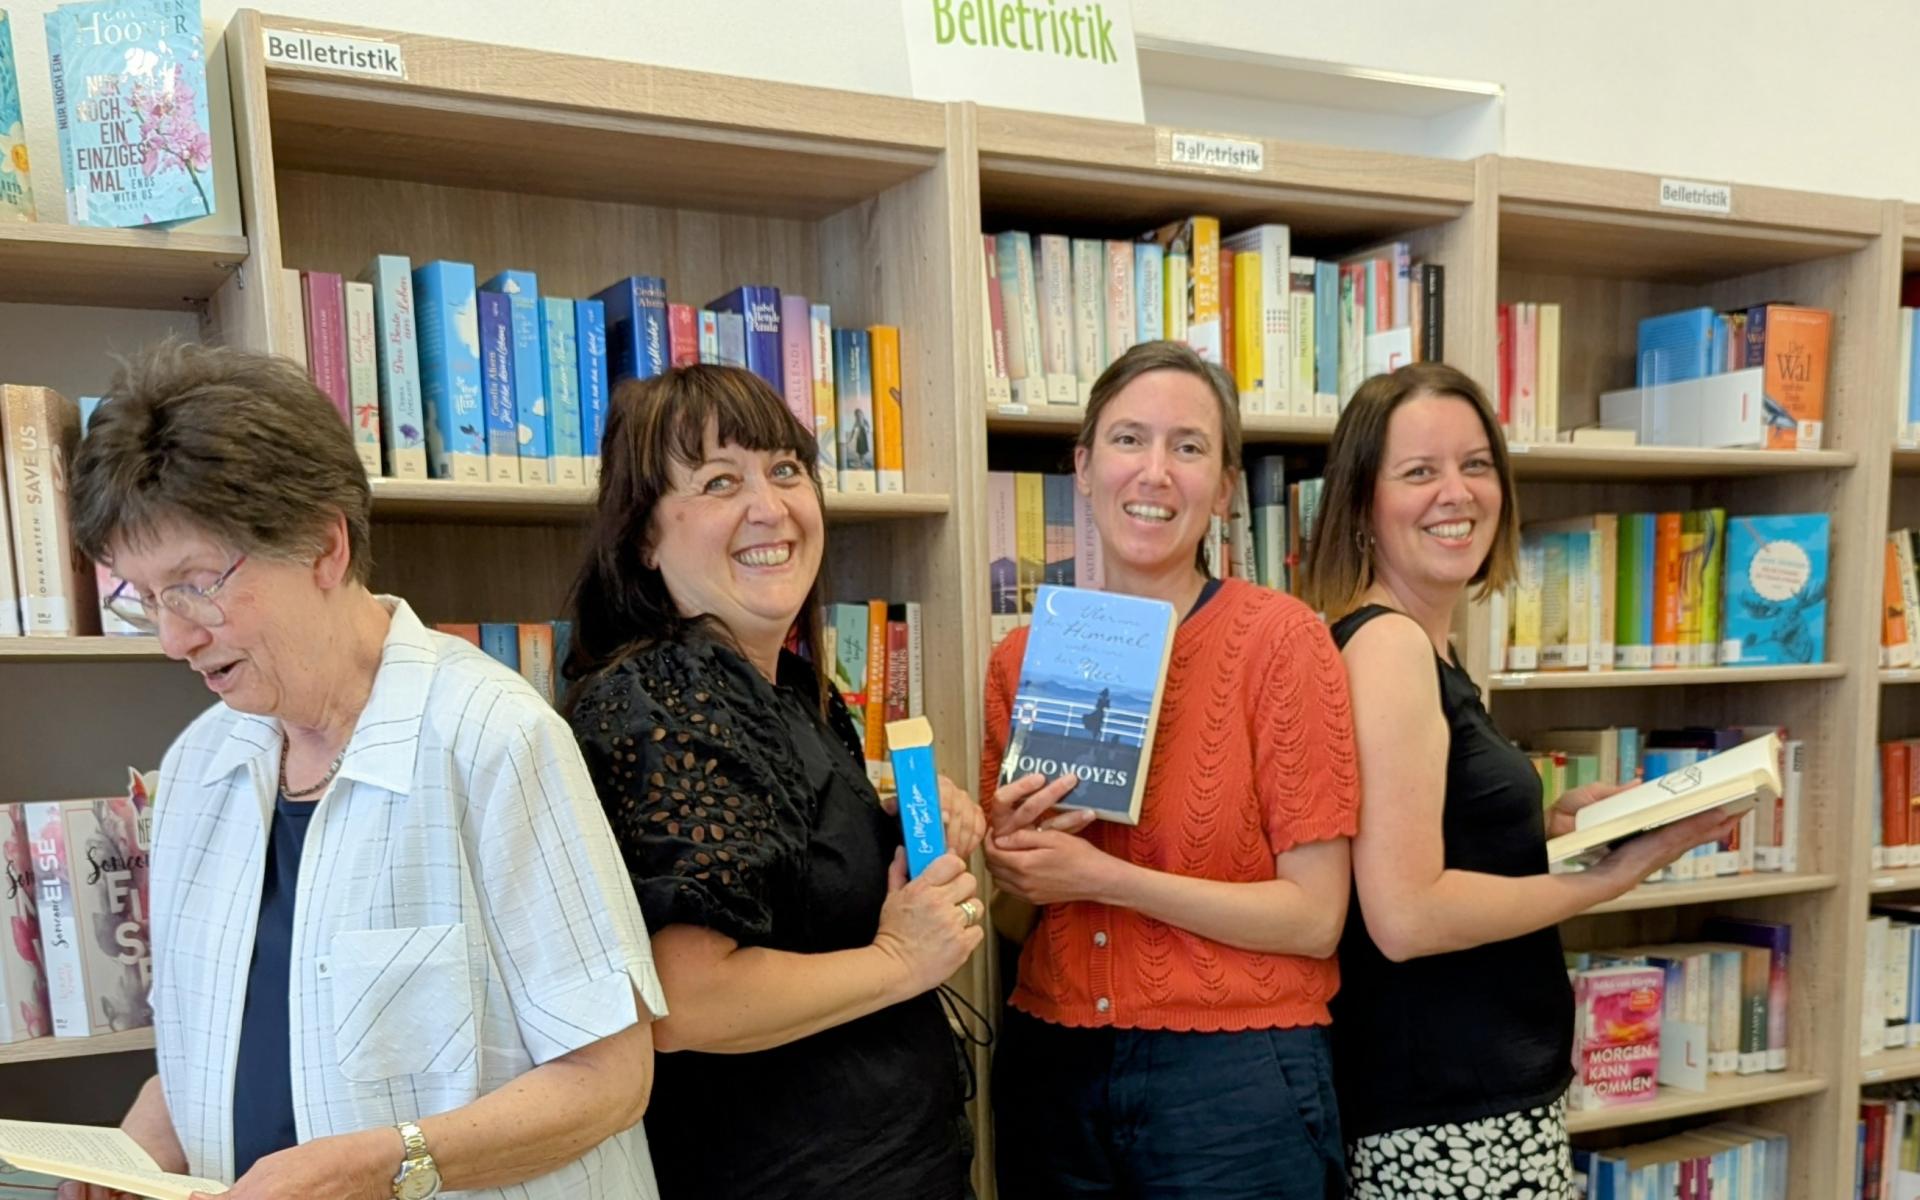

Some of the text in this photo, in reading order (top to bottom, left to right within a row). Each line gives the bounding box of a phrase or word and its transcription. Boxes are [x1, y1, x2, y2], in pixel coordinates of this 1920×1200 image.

[932, 0, 1118, 64] Belletristik
[52, 54, 62, 73] EIN
[268, 36, 399, 72] Belletristik
[54, 75, 66, 105] NOCH
[100, 120, 126, 145] EIN
[77, 142, 147, 170] EINZIGES
[89, 168, 126, 193] MAL
[1661, 184, 1729, 208] Belletristik
[790, 342, 802, 401] ALLENDE
[1777, 353, 1812, 381] Wal
[19, 425, 43, 505] SAVE US
[33, 517, 48, 599] ONA KASTEN
[1084, 550, 1096, 582] KATIE
[1060, 762, 1128, 787] MOYES
[38, 838, 63, 903] ELSE
[1588, 1045, 1653, 1064] MORGEN
[1685, 1041, 1697, 1068] L
[1588, 1062, 1630, 1080] KANN
[1587, 1075, 1651, 1096] KOMMEN
